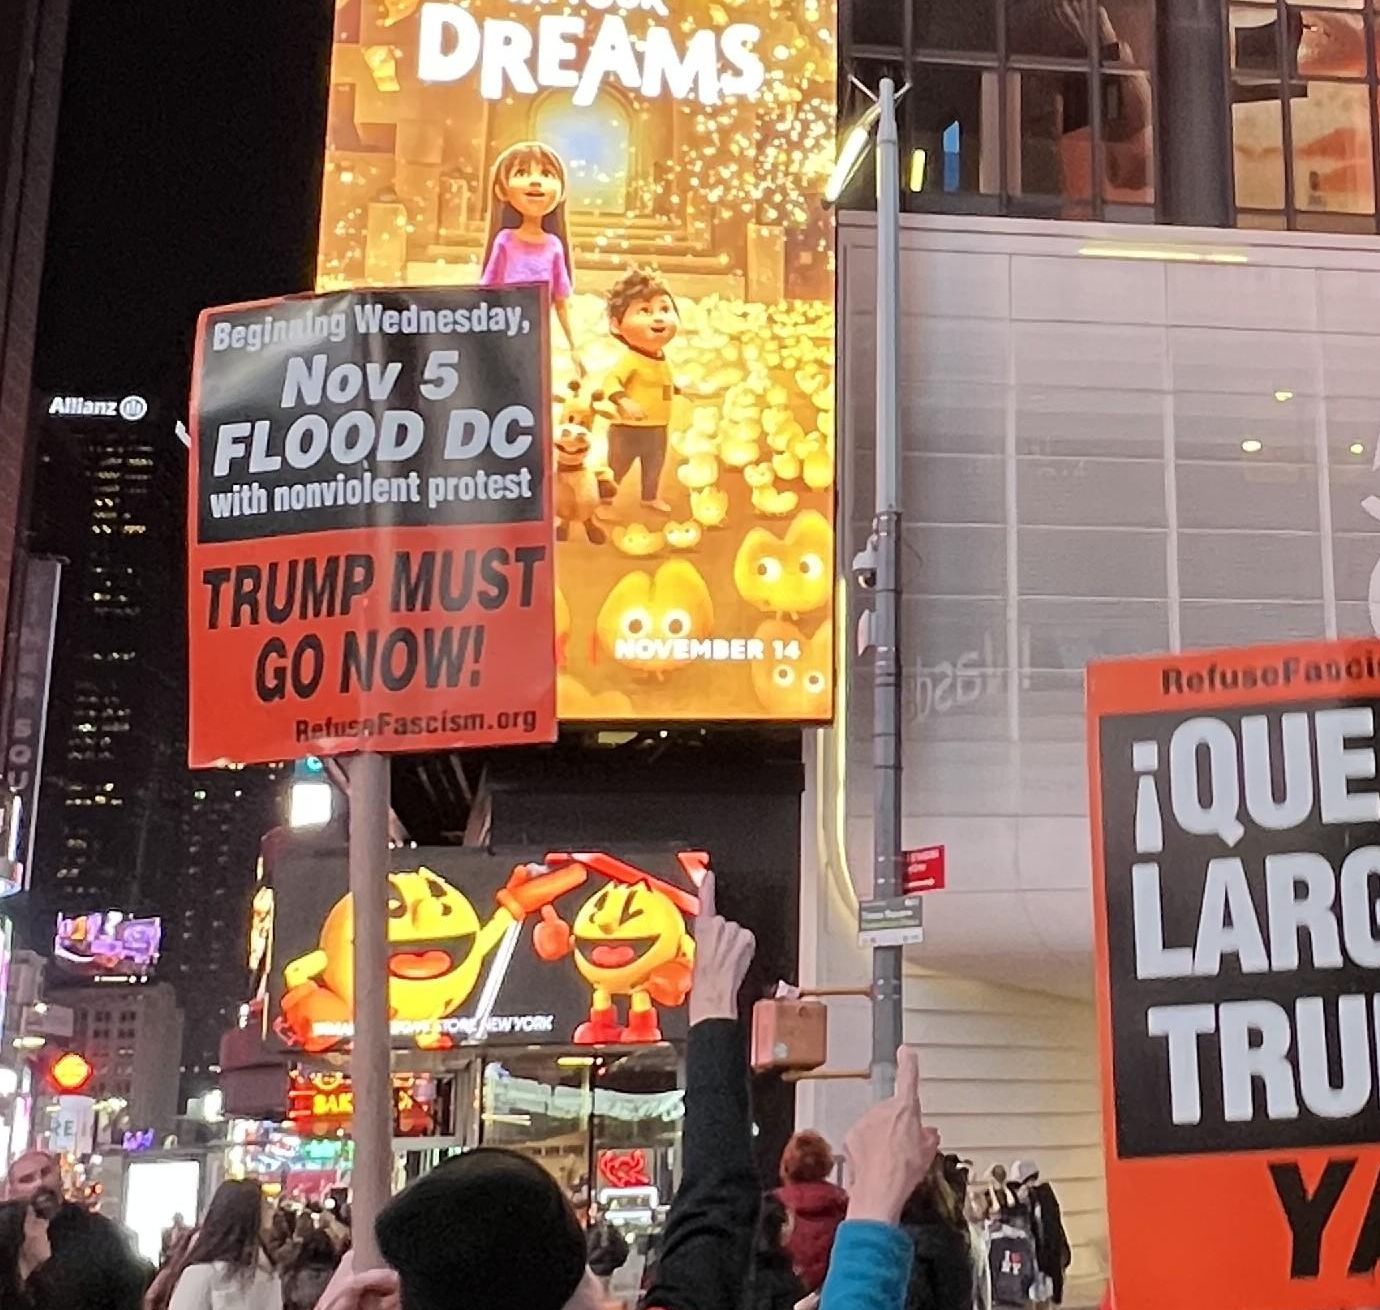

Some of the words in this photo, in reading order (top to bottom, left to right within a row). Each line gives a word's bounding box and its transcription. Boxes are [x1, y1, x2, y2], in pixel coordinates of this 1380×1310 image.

[417, 1, 766, 107] DREAMS
[213, 305, 346, 352] Beginning
[355, 301, 530, 338] Wednesday,
[49, 396, 117, 416] Allianz
[280, 353, 402, 409] Nov
[420, 350, 460, 400] 5
[213, 410, 425, 478] FLOOD
[444, 405, 536, 460] DC
[210, 483, 267, 519] with
[274, 471, 421, 513] nonviolent
[428, 467, 532, 510] protest
[202, 553, 375, 630] TRUMP
[390, 545, 547, 613] MUST
[255, 632, 324, 703] GO
[340, 624, 485, 695] NOW!
[614, 637, 765, 661] NOVEMBER
[772, 639, 800, 661] 14
[296, 710, 537, 744] RefuseFascism.org
